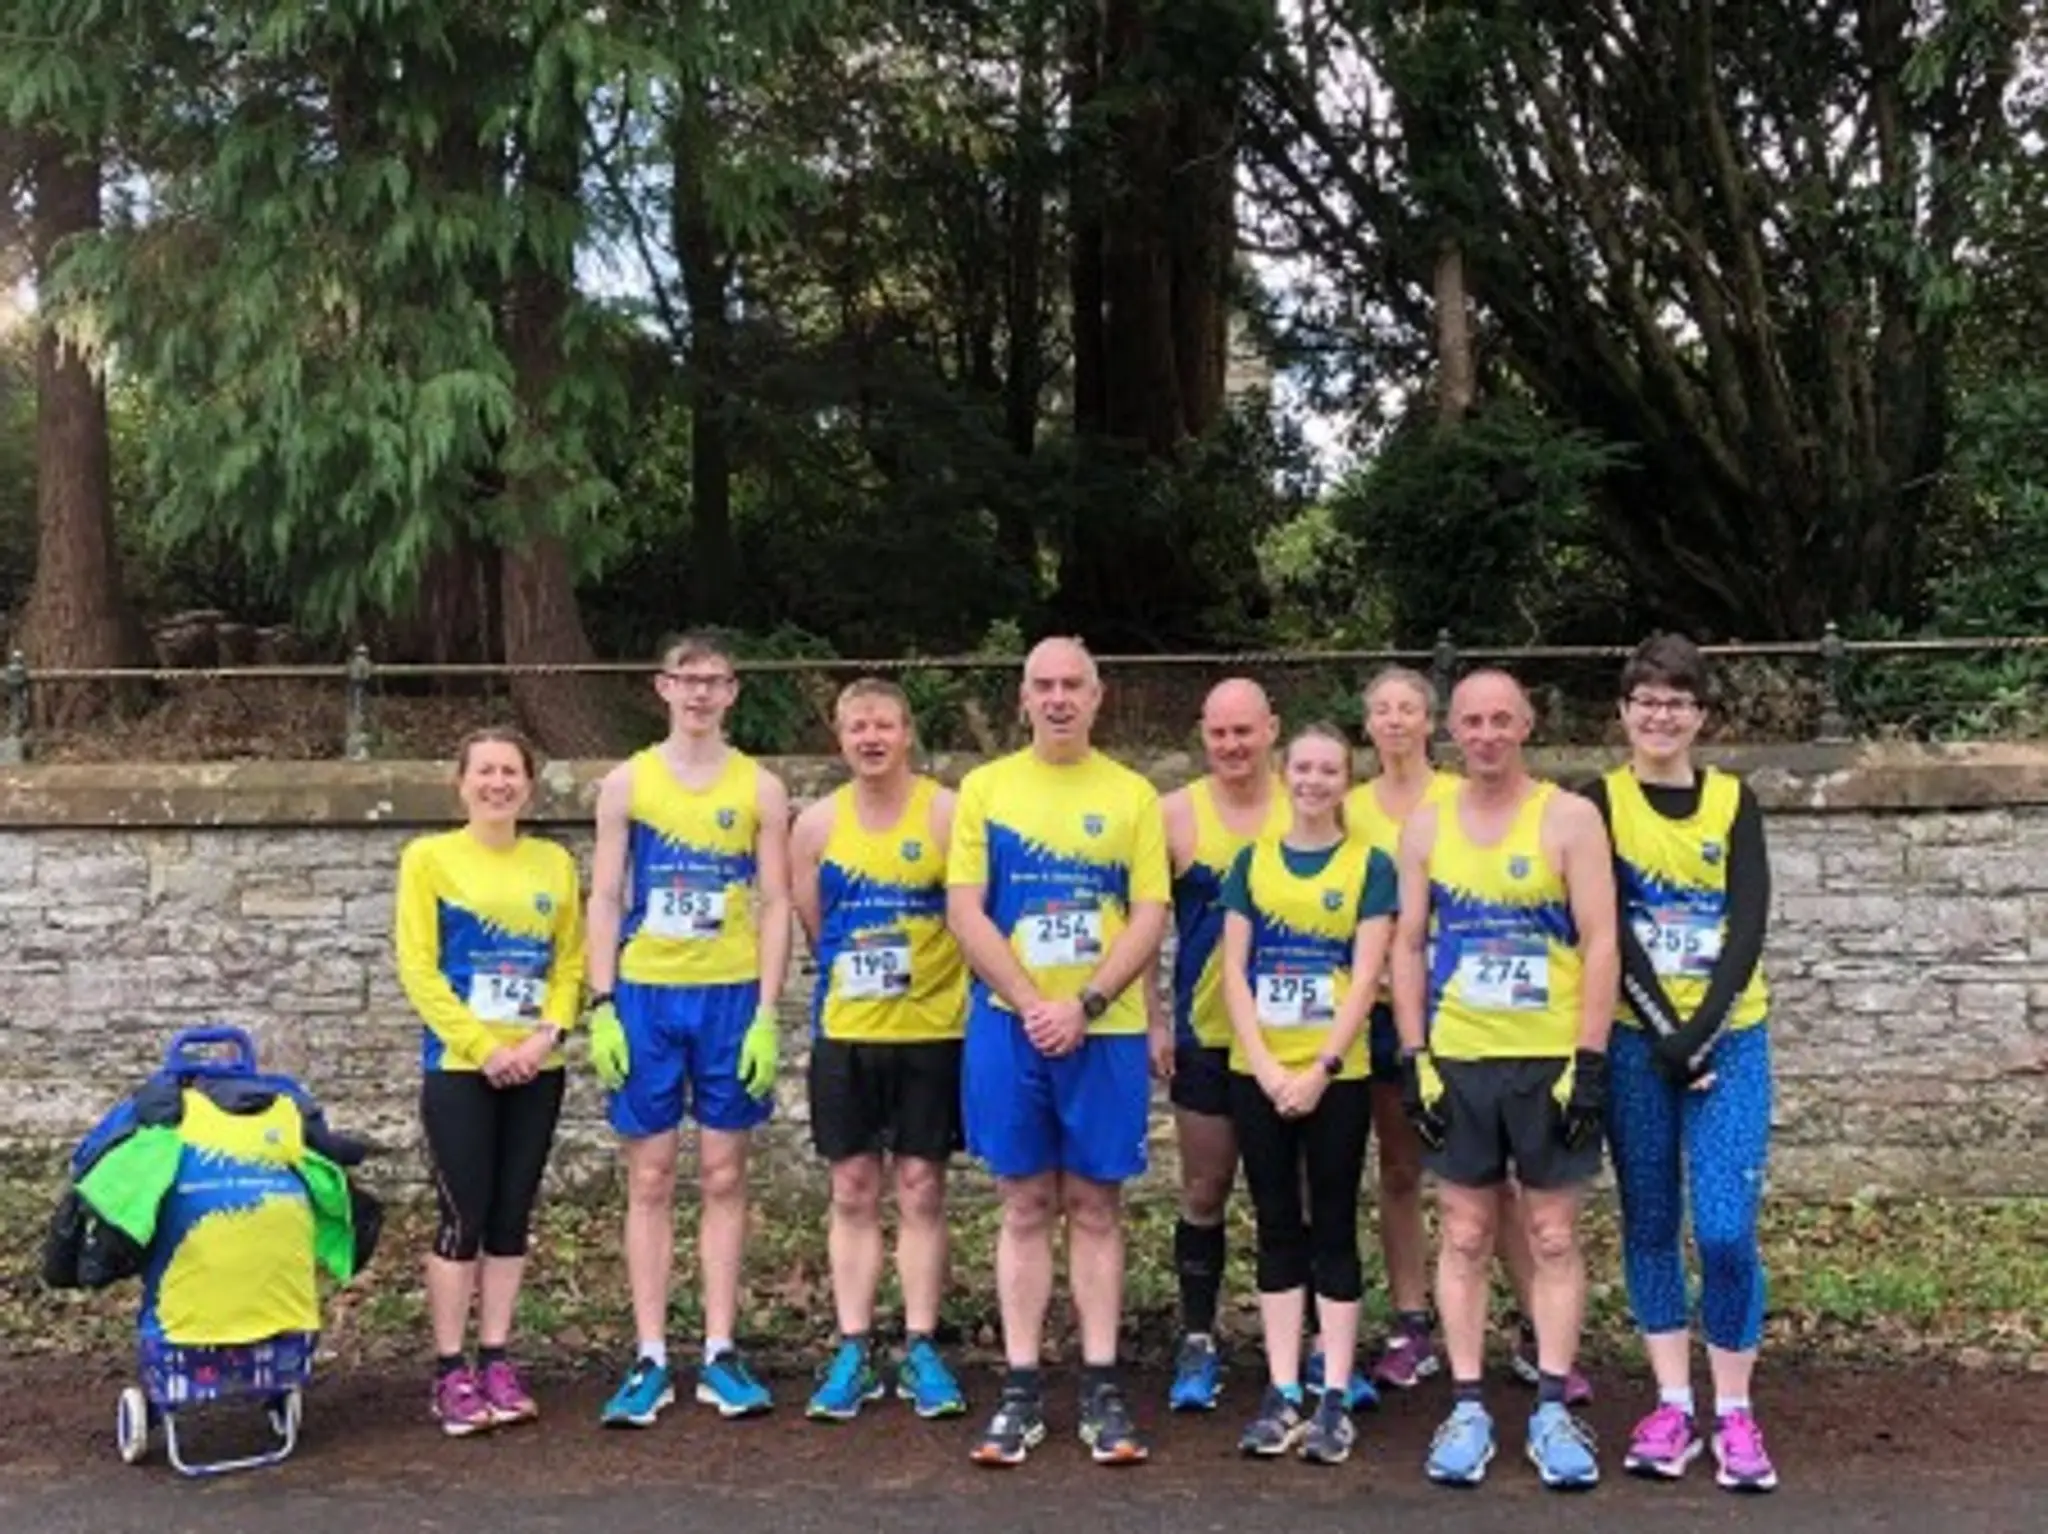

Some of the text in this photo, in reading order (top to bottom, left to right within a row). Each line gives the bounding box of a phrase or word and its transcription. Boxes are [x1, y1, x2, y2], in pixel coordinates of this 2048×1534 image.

[1037, 913, 1090, 943] 254
[1476, 956, 1531, 984] 274
[1269, 976, 1317, 1003] 275
